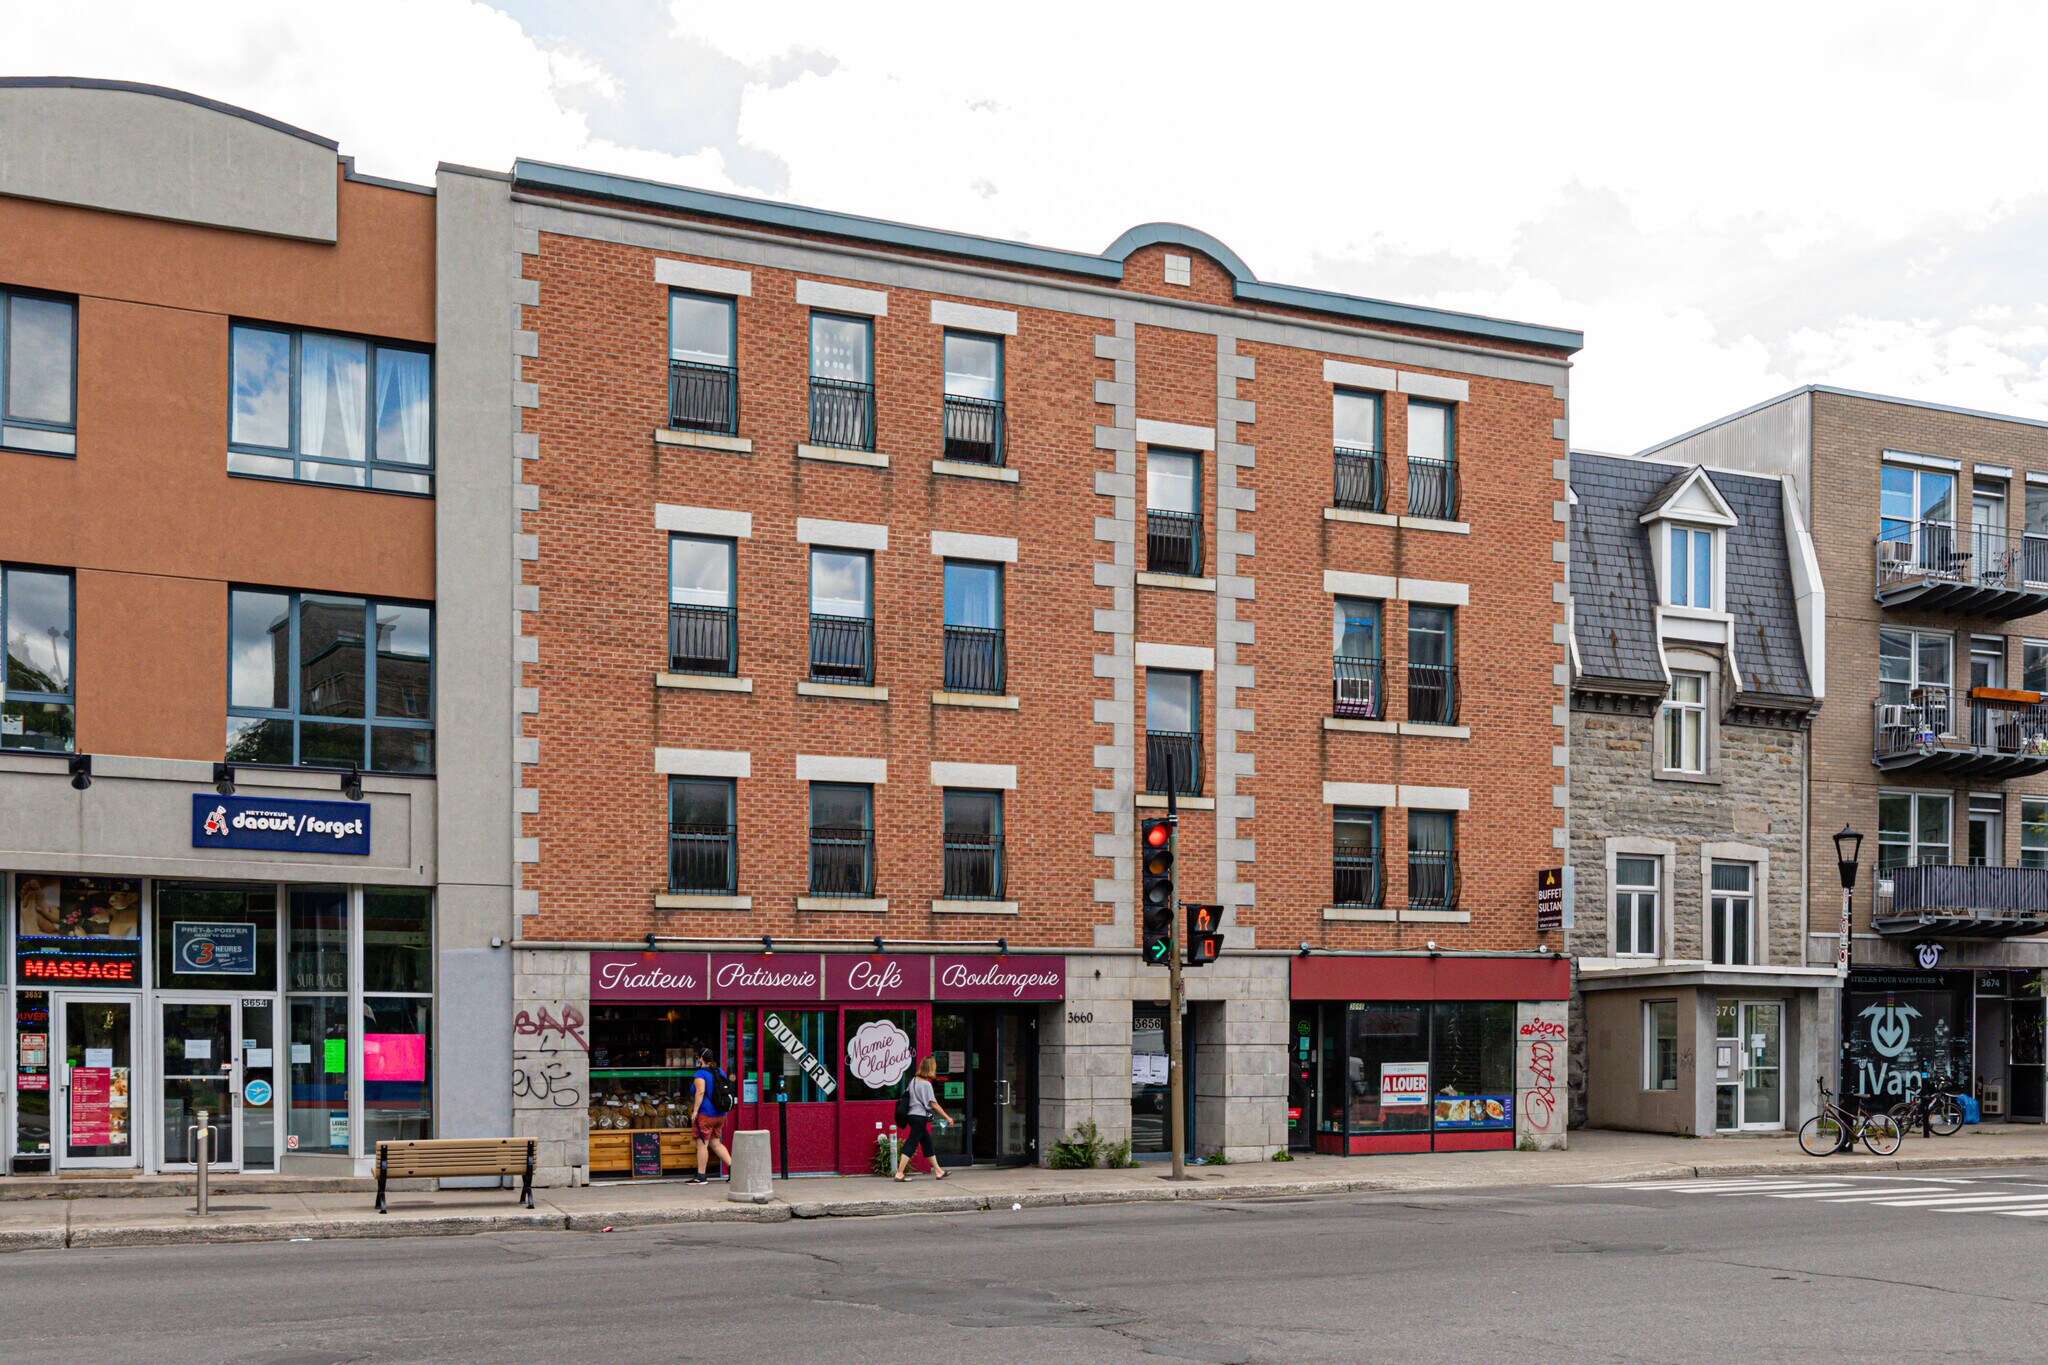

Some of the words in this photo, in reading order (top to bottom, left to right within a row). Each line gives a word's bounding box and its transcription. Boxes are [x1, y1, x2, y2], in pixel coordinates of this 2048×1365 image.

[1538, 888, 1562, 900] BUFFET
[1538, 901, 1562, 912] SULTAN
[196, 943, 215, 963] 3
[215, 945, 242, 953] HEURES
[25, 960, 132, 979] MASSAGE
[599, 962, 696, 990] Traiteur
[717, 963, 816, 988] Patisserie
[849, 961, 903, 997] Café
[297, 973, 314, 987] SUR
[942, 964, 1059, 997] Boulangerie
[1878, 976, 1897, 984] POUR
[1898, 976, 1936, 984] VAPOTEURS
[1981, 978, 2000, 988] 3674
[243, 999, 267, 1007] 3654
[1067, 1012, 1093, 1024] 3660
[765, 1014, 837, 1094] OUVERT
[845, 1036, 895, 1066] Mamie
[857, 1046, 917, 1078] Clafoutis
[1383, 1077, 1391, 1092] A
[1392, 1076, 1426, 1091] LOUER
